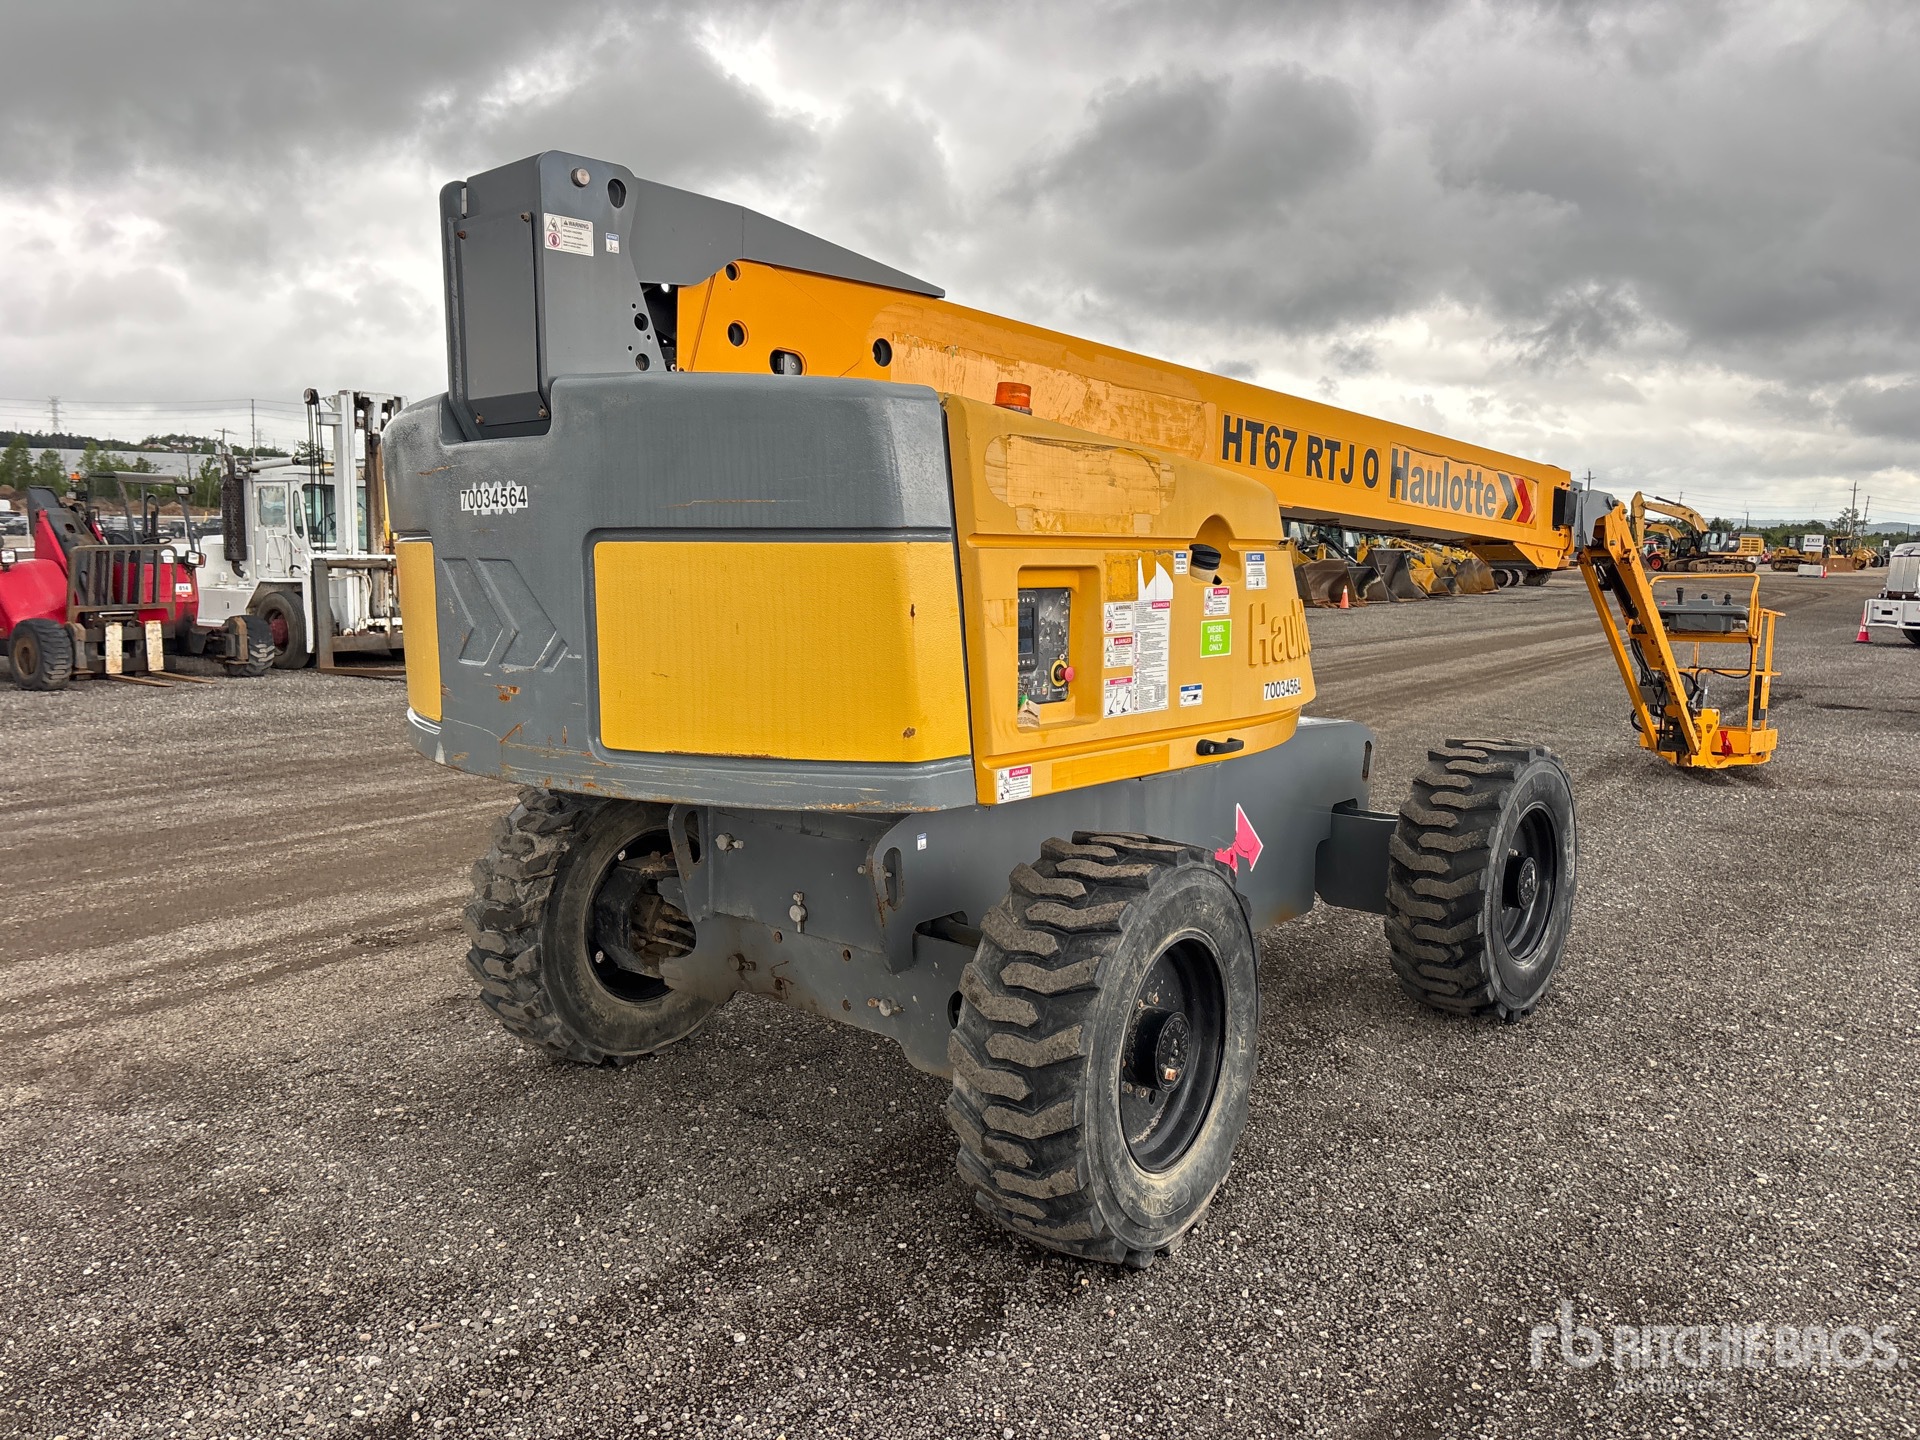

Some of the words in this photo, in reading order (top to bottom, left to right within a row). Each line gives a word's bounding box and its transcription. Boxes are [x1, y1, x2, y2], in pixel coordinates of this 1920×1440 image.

[1222, 414, 1298, 473] HT67
[1306, 434, 1355, 484] RTJ
[1390, 448, 1497, 518] Haulotte
[461, 486, 527, 510] 70034564
[1206, 625, 1226, 634] DIESEL
[1209, 634, 1223, 643] FUEL
[1208, 643, 1223, 652] ONLY
